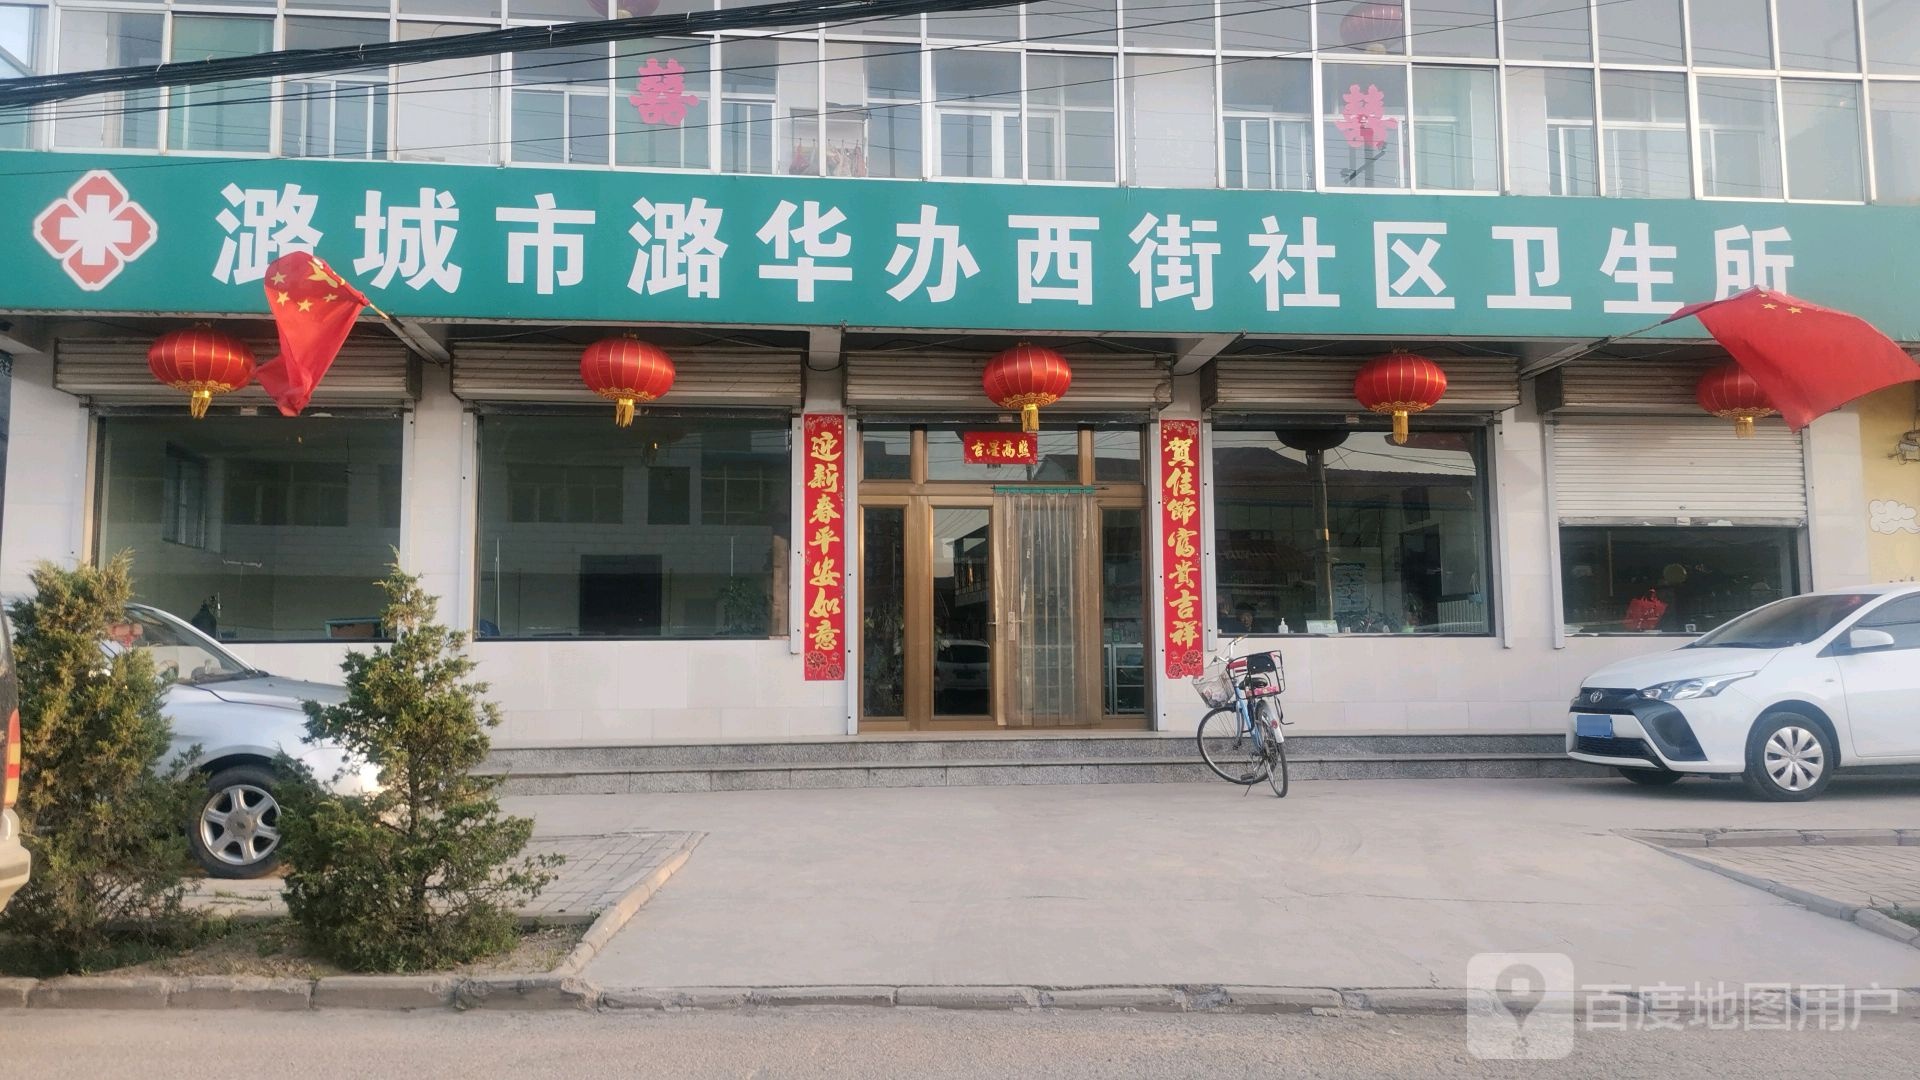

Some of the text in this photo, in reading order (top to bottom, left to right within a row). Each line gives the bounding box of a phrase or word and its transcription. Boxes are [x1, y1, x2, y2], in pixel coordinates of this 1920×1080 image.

[971, 439, 1031, 458] 吉星高照
[807, 431, 841, 651] 迎新春平安如意
